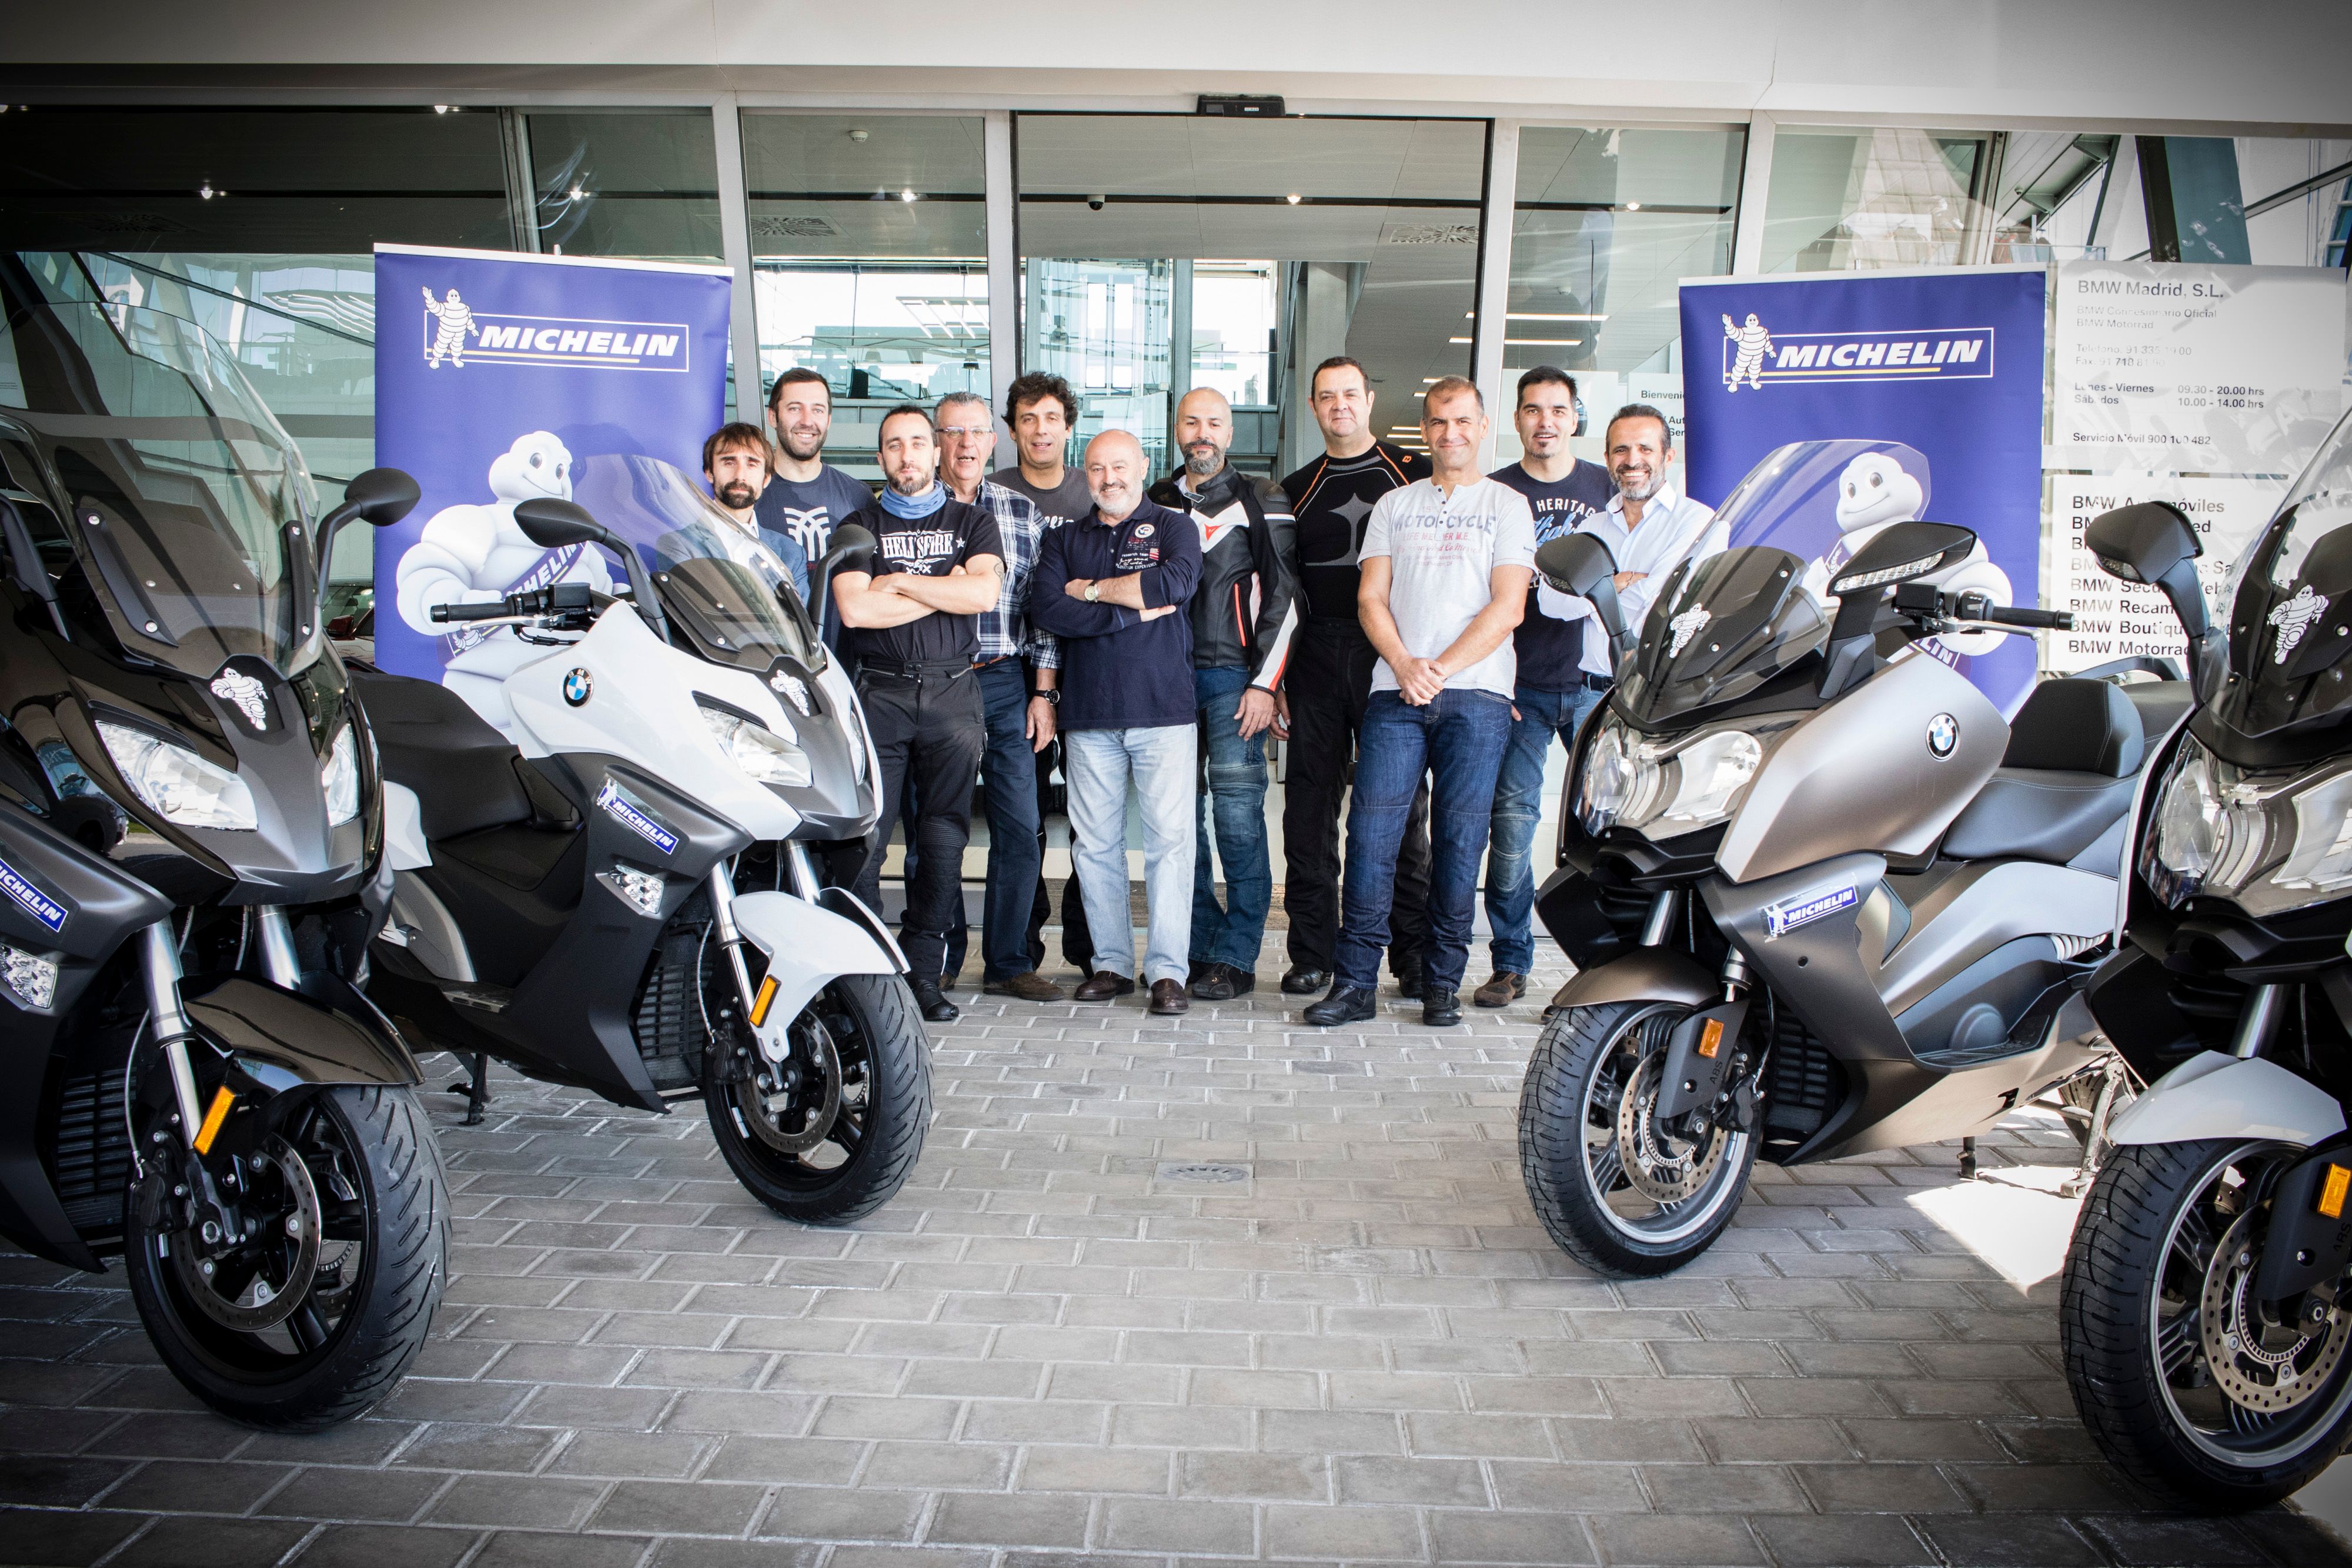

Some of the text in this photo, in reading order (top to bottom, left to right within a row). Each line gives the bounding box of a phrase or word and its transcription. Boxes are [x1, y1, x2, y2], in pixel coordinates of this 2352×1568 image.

[2077, 280, 2224, 299] BMW Madrid, S.L.
[2077, 306, 2104, 315] BMW
[2184, 309, 2217, 318] Oficial
[2077, 319, 2154, 329] BMW Motorrad
[479, 326, 679, 357] MICHELIN
[1776, 340, 1983, 368] MICHELIN
[2126, 346, 2138, 354] 91
[2179, 347, 2192, 356] 00
[1641, 390, 1684, 399] Bienveni
[2116, 383, 2154, 393] Viernes
[2177, 385, 2207, 393] 09.30
[2217, 386, 2246, 395] 20.00
[2248, 386, 2264, 396] hrs
[2074, 394, 2119, 404] Sábdos
[2178, 397, 2207, 406] 10.00
[2217, 399, 2245, 407] 14.00
[2247, 399, 2264, 408] hrs
[2073, 432, 2114, 442] Servicio
[2147, 434, 2167, 443] 900
[2191, 436, 2211, 444] 482
[1536, 498, 1596, 518] HERITAG
[2072, 496, 2116, 510] BMW
[2070, 578, 2113, 592] BMW
[2070, 599, 2113, 613] BMW
[2070, 620, 2183, 638] BMW Boutiqu
[2069, 640, 2111, 653] BMW
[612, 801, 674, 847] MICHELIN
[0, 865, 62, 922] ICHELIN
[1788, 889, 1853, 923] MICHELIN
[1709, 1060, 1723, 1085] ABS
